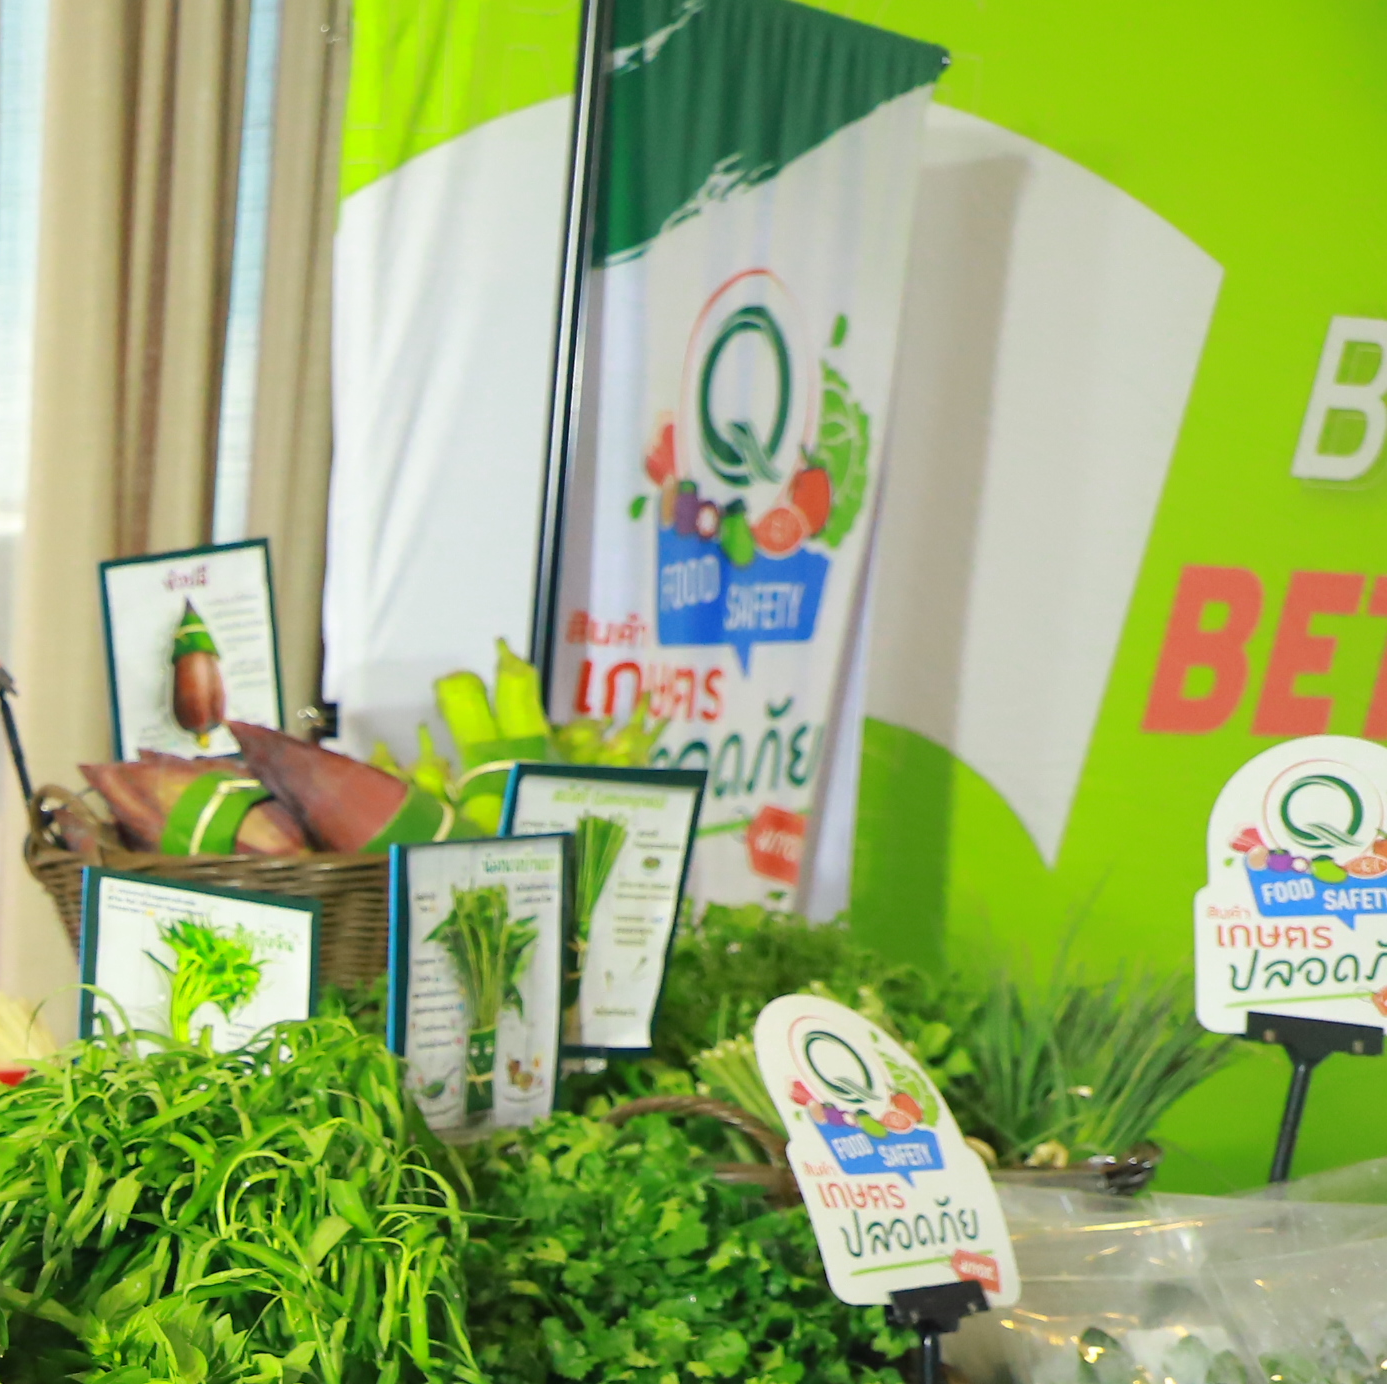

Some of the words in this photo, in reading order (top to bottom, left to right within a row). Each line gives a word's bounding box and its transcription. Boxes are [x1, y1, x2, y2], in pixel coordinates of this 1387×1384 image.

[1261, 878, 1315, 905] FOOD
[1323, 887, 1387, 911] SAFET
[1217, 924, 1334, 950] เกษตร
[831, 1133, 874, 1161] FOOD
[878, 1143, 933, 1168] SAFETY
[817, 1182, 906, 1210] เกษตร
[840, 1196, 978, 1257] ปลอดภัย
